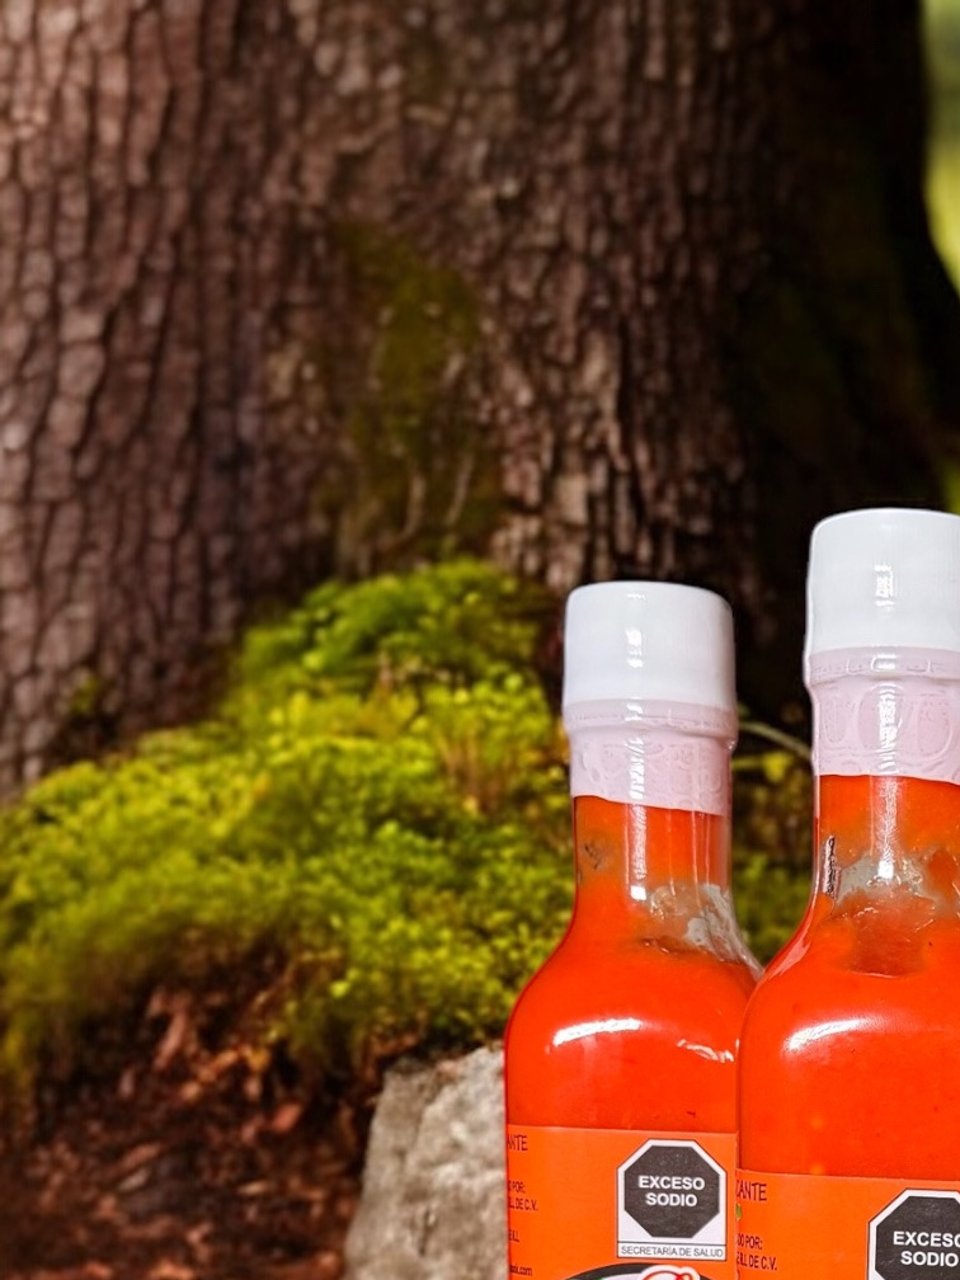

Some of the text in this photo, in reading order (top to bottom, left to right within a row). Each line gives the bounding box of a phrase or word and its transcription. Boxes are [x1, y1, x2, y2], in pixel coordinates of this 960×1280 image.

[638, 1175, 706, 1190] EXCESO
[645, 1192, 698, 1207] SODIO
[680, 1247, 692, 1256] DE
[693, 1247, 723, 1258] SALUD
[900, 1250, 959, 1267] SODIO
[761, 1256, 778, 1271] C.V.
